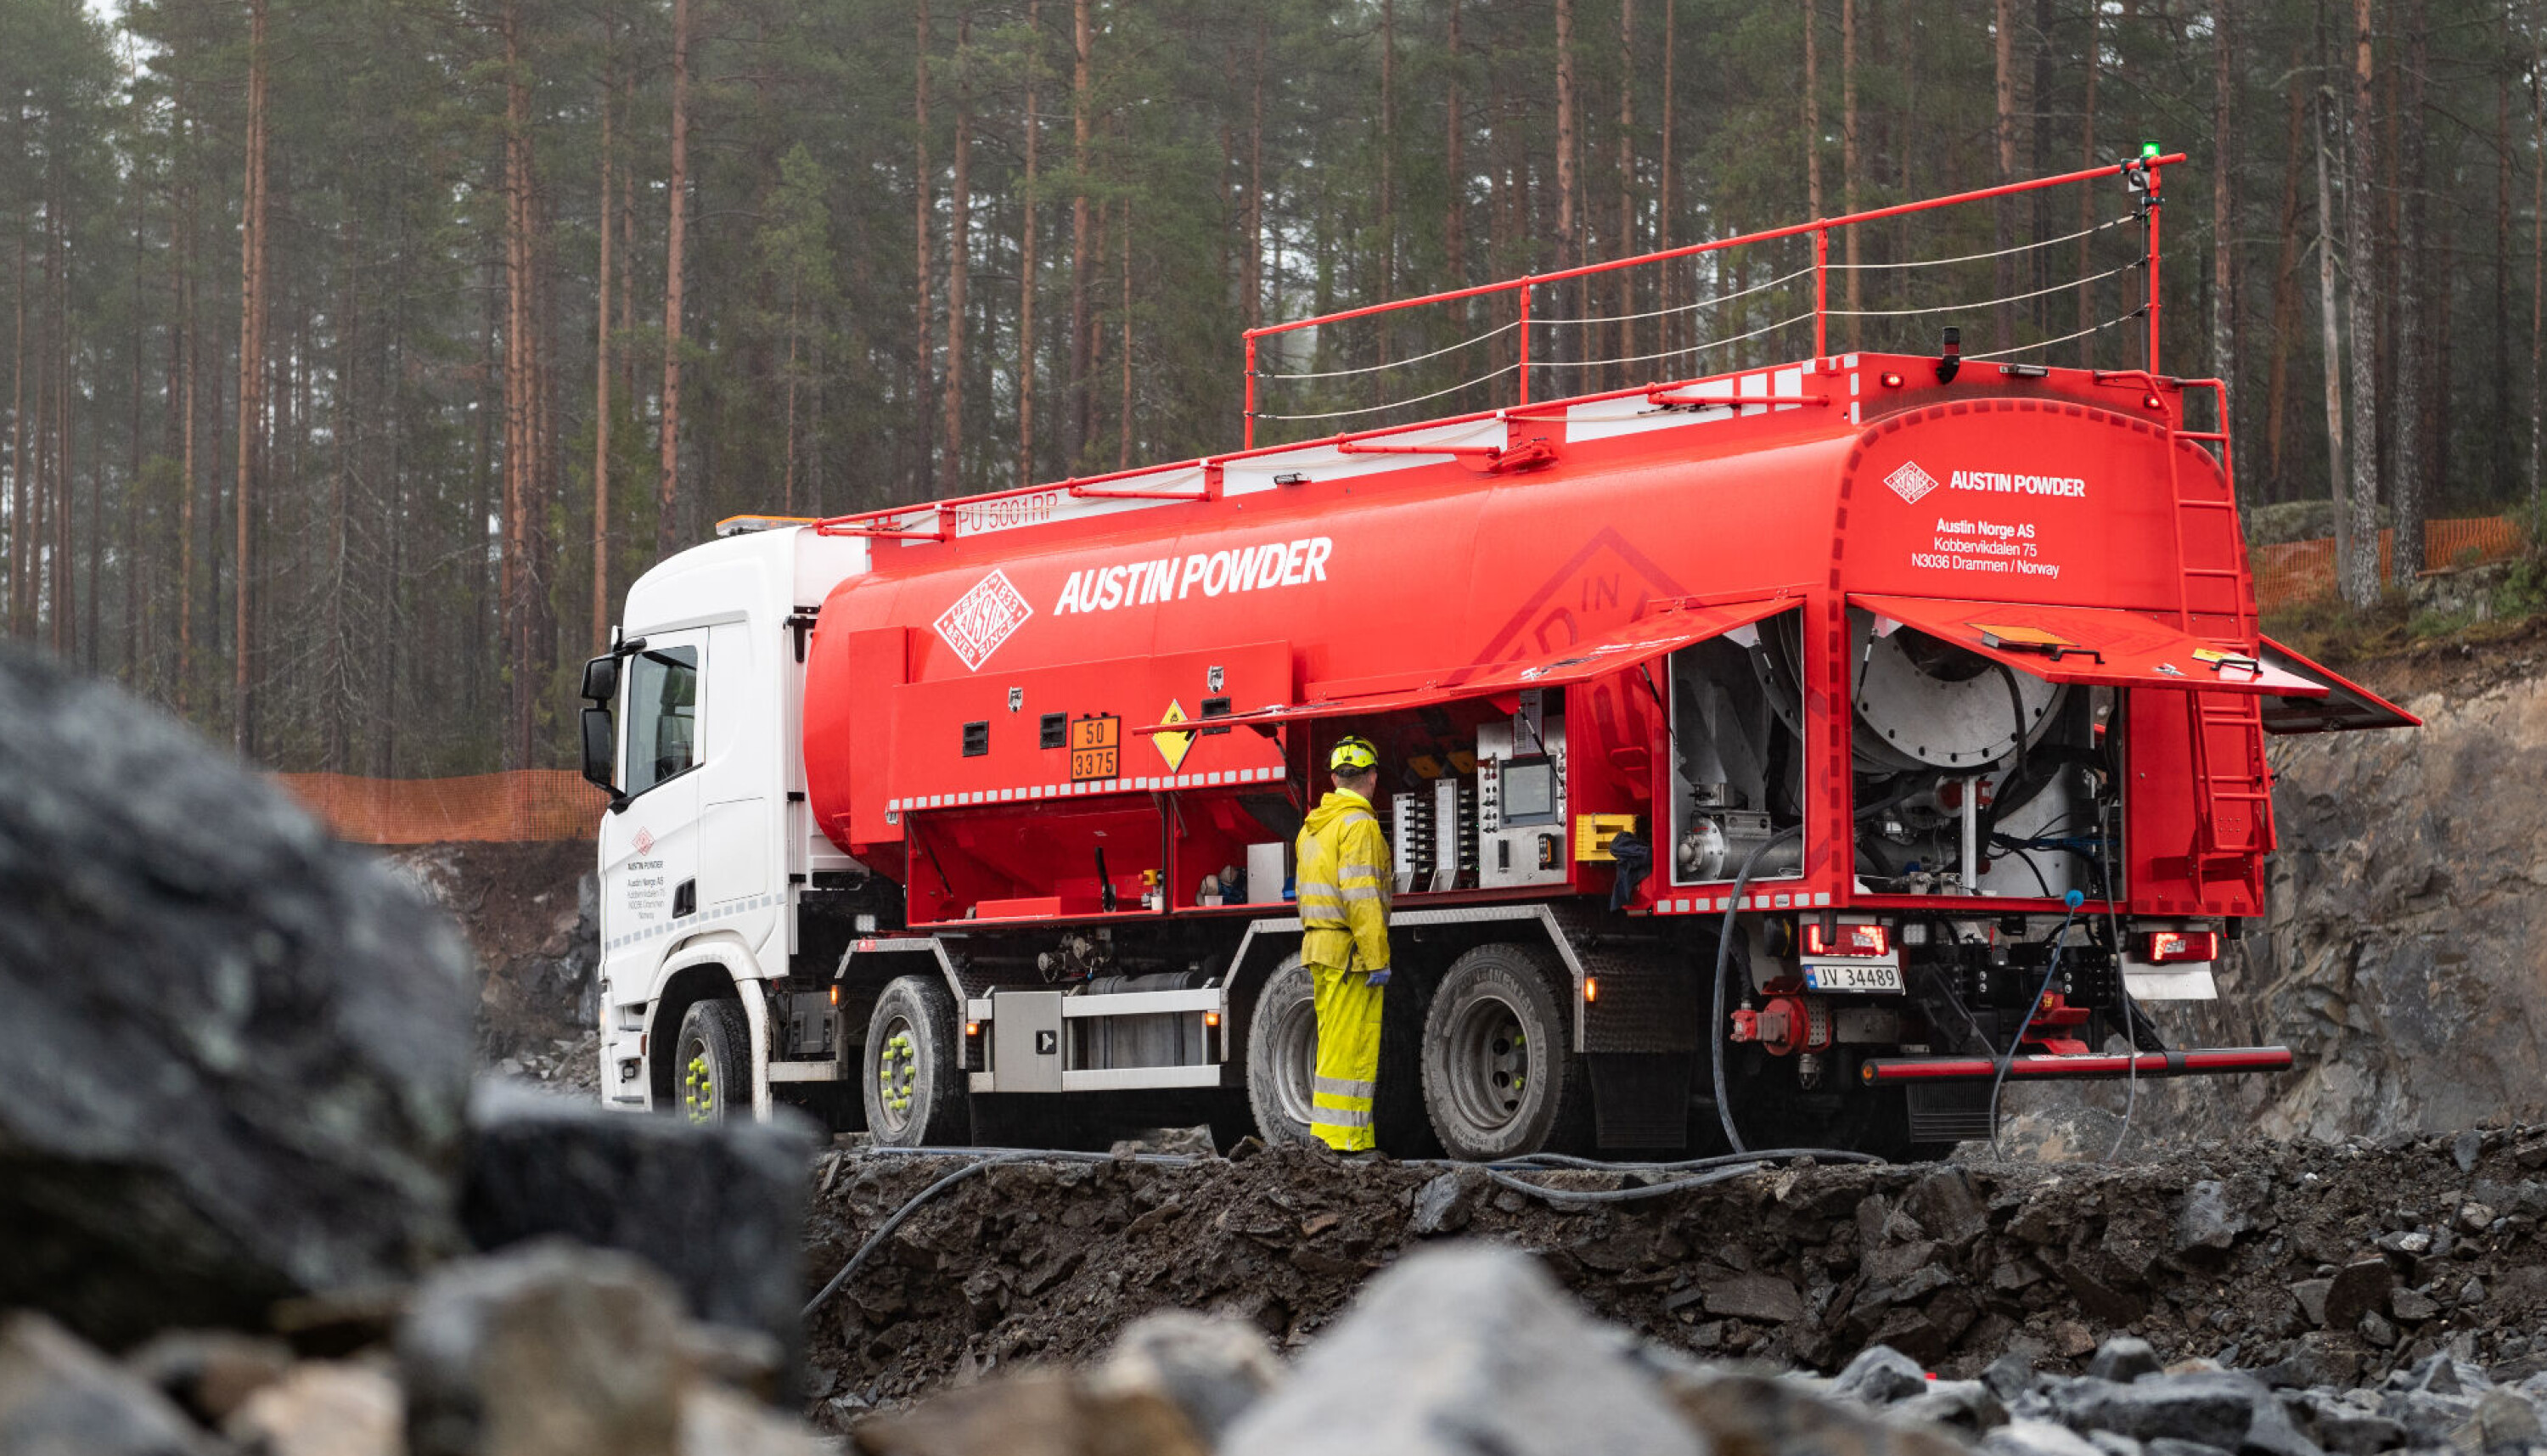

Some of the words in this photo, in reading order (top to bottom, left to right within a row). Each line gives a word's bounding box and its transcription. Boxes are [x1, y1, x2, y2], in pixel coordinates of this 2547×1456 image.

[1950, 471, 2011, 492] AUSTIN
[2015, 475, 2085, 497] POWDER
[959, 504, 982, 533] PU
[1937, 518, 1975, 534] Austin
[1978, 520, 2015, 539] Norge
[2017, 524, 2034, 538] AS
[1934, 537, 2020, 556] Kobbervikdalen
[2022, 543, 2037, 556] 75
[1053, 557, 1181, 616] AUSTIN
[1178, 537, 1333, 599] POWDER
[1911, 553, 1949, 569] N3036
[1953, 555, 2008, 572] Drammen
[2010, 559, 2016, 573] /
[2016, 559, 2061, 579] Norway
[952, 582, 990, 620] USED
[1581, 573, 1620, 613] IN
[978, 616, 1015, 658] SINCE
[1086, 722, 1105, 744] 50
[1075, 751, 1114, 776] 3375
[1822, 969, 1837, 986] JV
[1846, 969, 1895, 987] 34489
